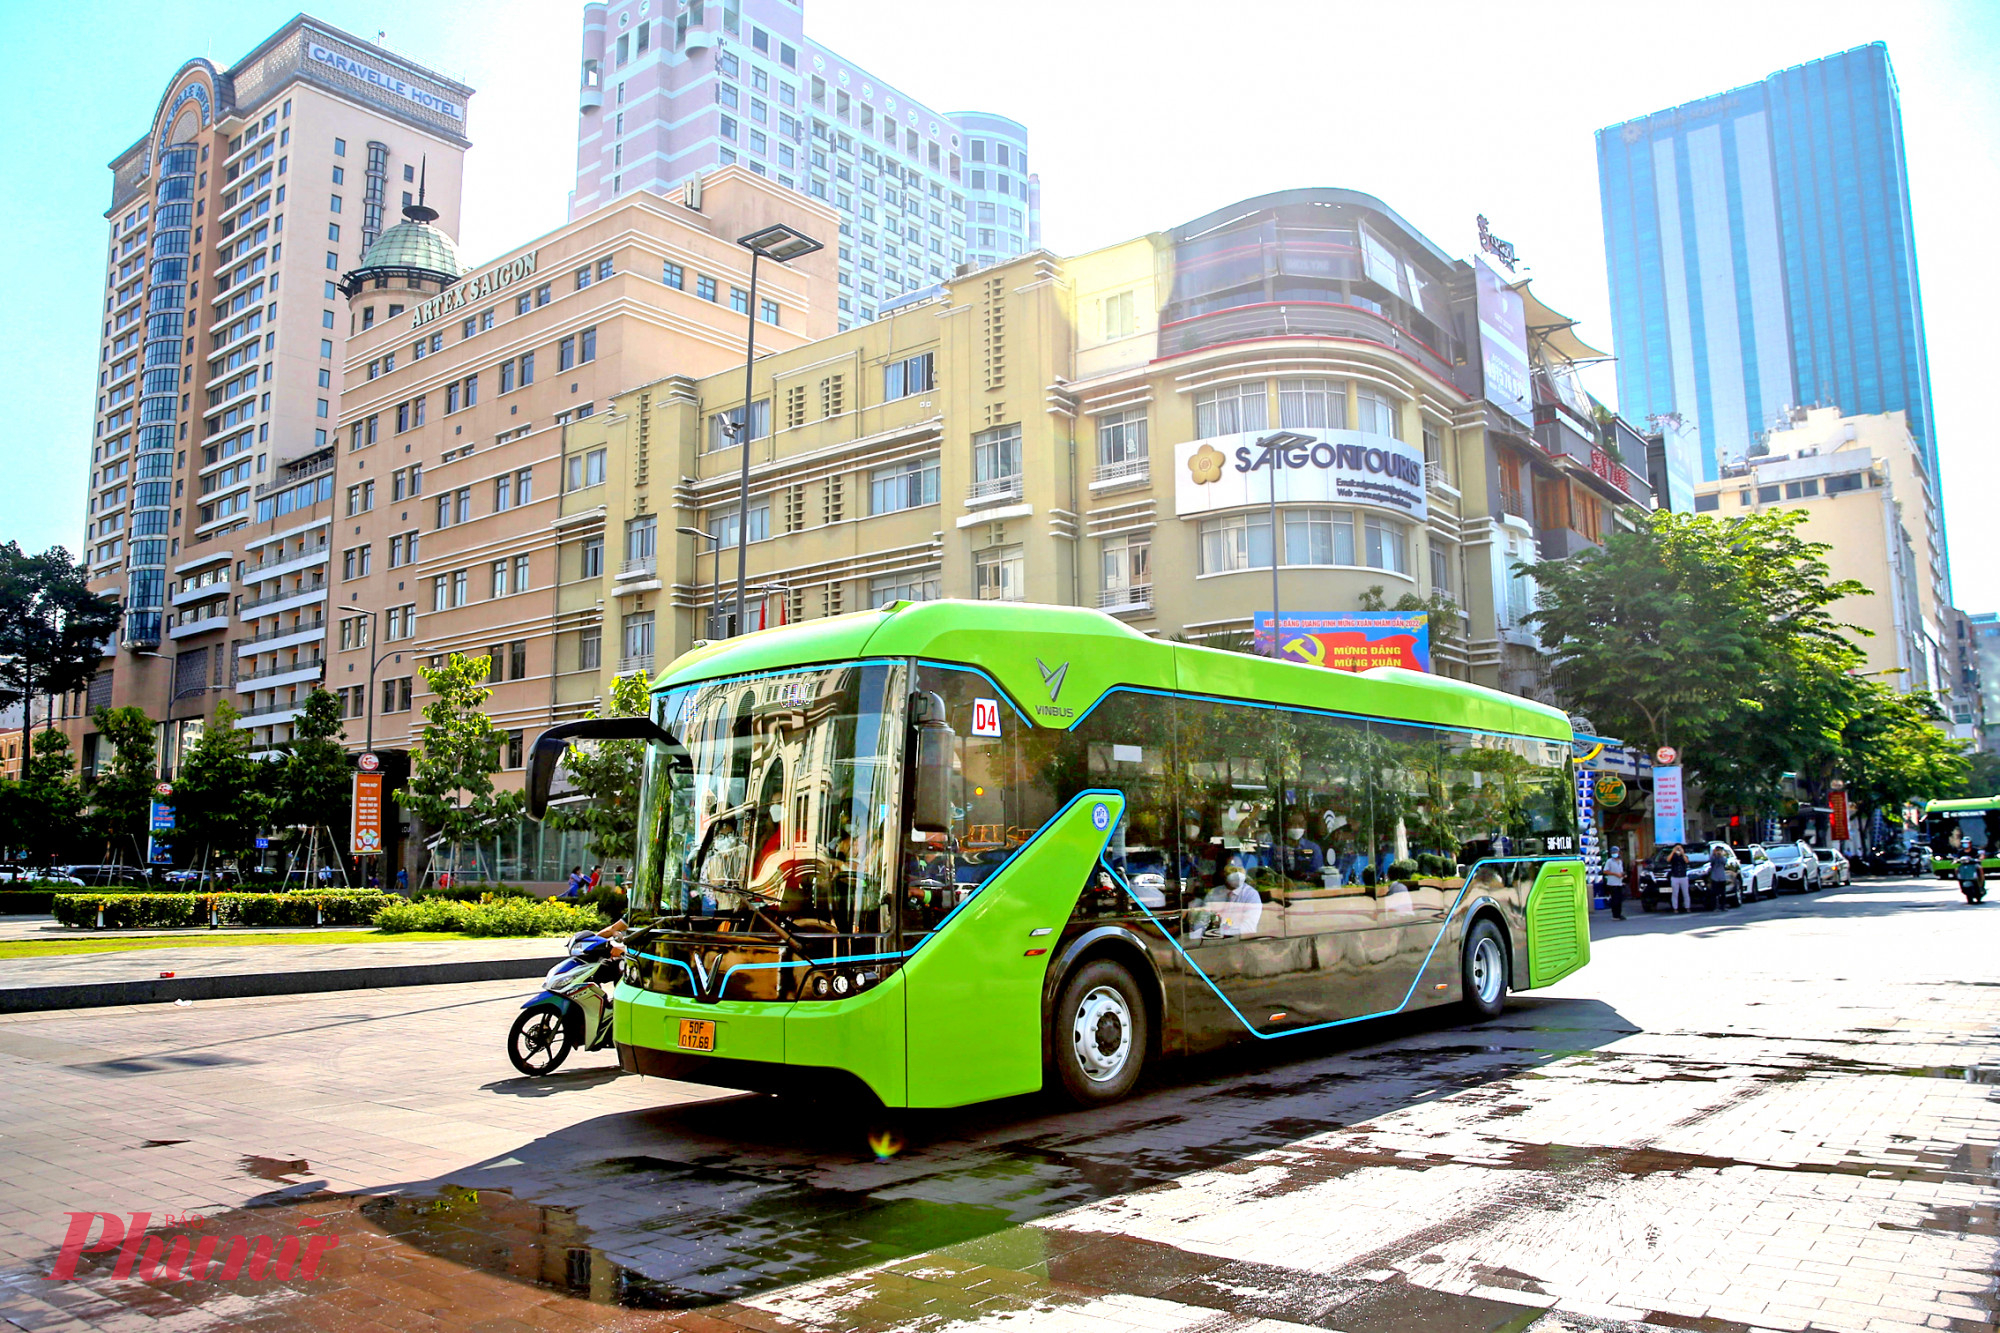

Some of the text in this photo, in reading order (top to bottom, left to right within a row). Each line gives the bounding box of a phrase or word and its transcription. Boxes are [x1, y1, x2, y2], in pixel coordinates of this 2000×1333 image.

[313, 47, 460, 119] CARAVELLE HOTEL
[411, 250, 538, 329] ARTEX SAIGON
[1234, 442, 1422, 487] SAIGONTOURIST
[1322, 619, 1336, 628] VINH
[1404, 619, 1420, 628] 2022
[1370, 644, 1401, 655] ĐẢNG
[1371, 657, 1402, 667] XUÂN
[976, 703, 997, 731] D4
[1035, 705, 1074, 718] VINBUS
[689, 1021, 705, 1035] 50F
